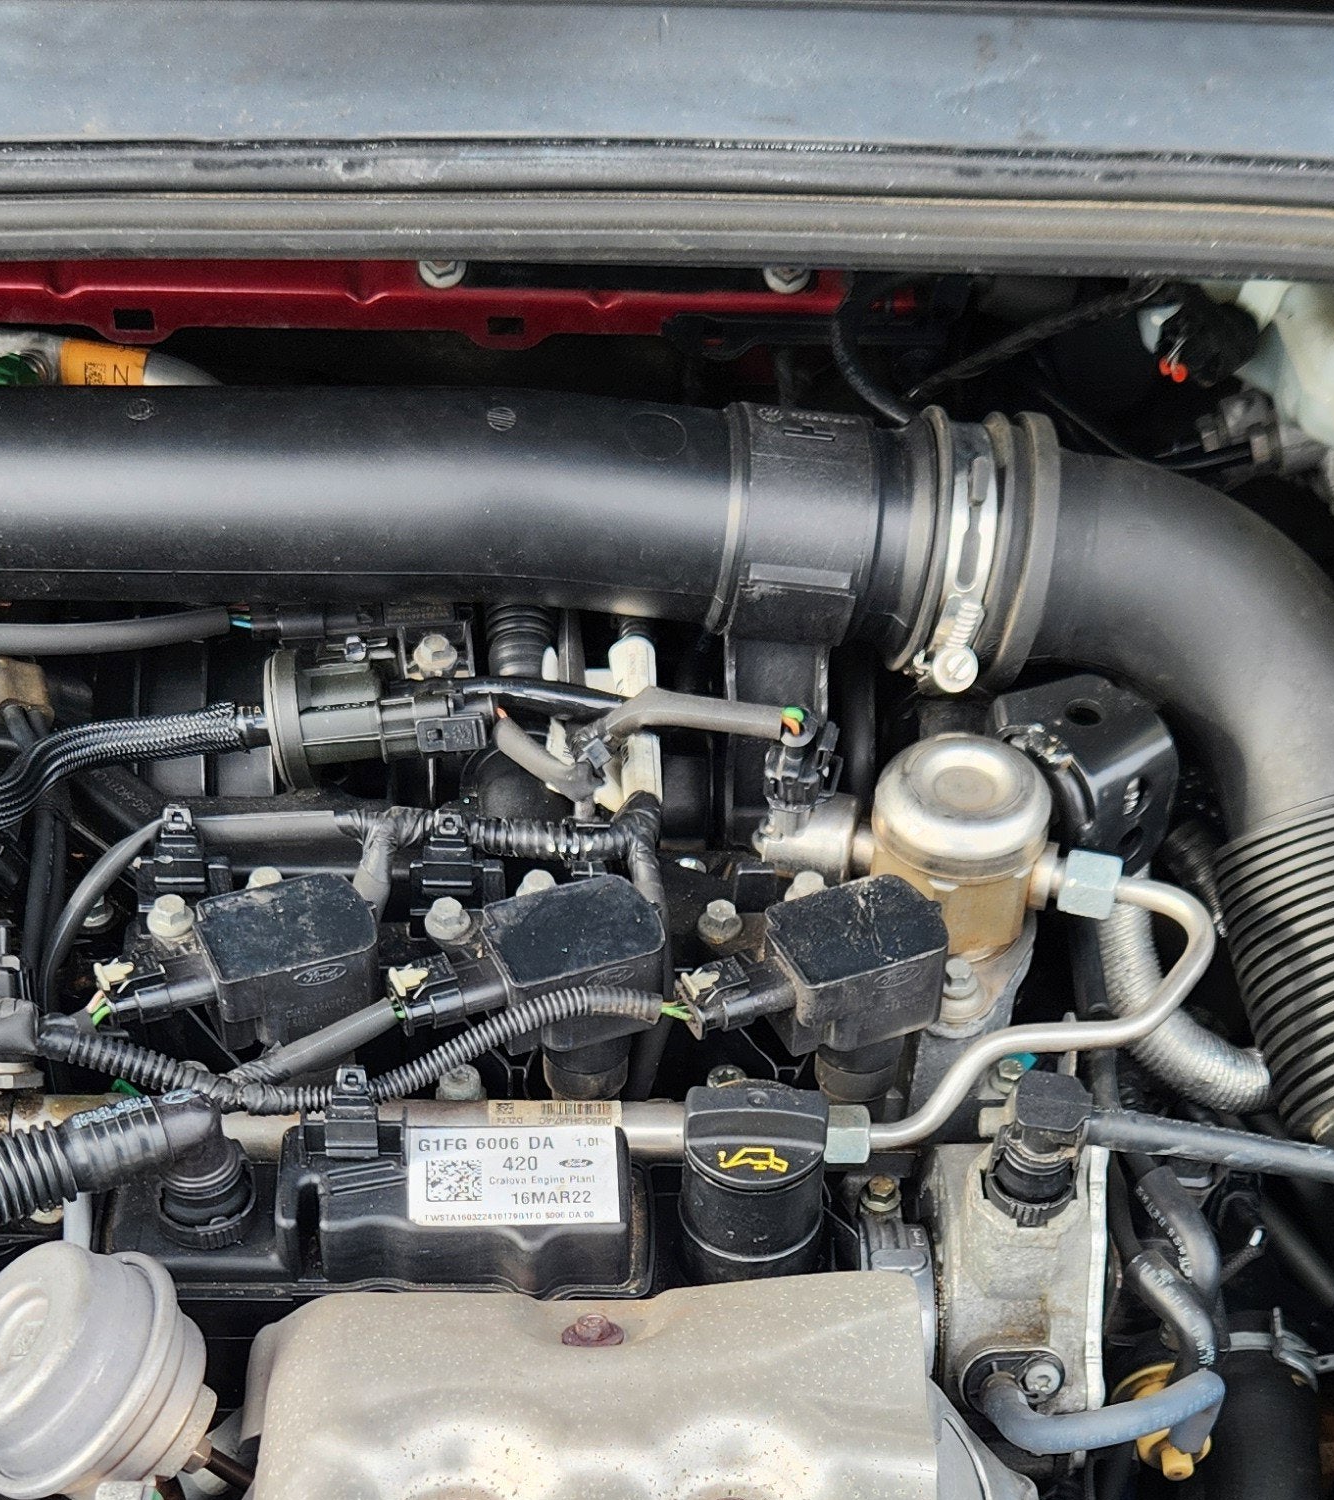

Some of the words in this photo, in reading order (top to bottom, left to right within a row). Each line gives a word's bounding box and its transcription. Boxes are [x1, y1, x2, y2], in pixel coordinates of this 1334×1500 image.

[418, 1138, 468, 1152] G1FG
[476, 1137, 520, 1150] 6006
[528, 1136, 555, 1150] DA
[502, 1156, 539, 1171] 420
[489, 1176, 527, 1185] Craiova
[531, 1176, 565, 1185] Engine
[569, 1174, 596, 1184] Plant
[512, 1190, 592, 1205] 16MAR22
